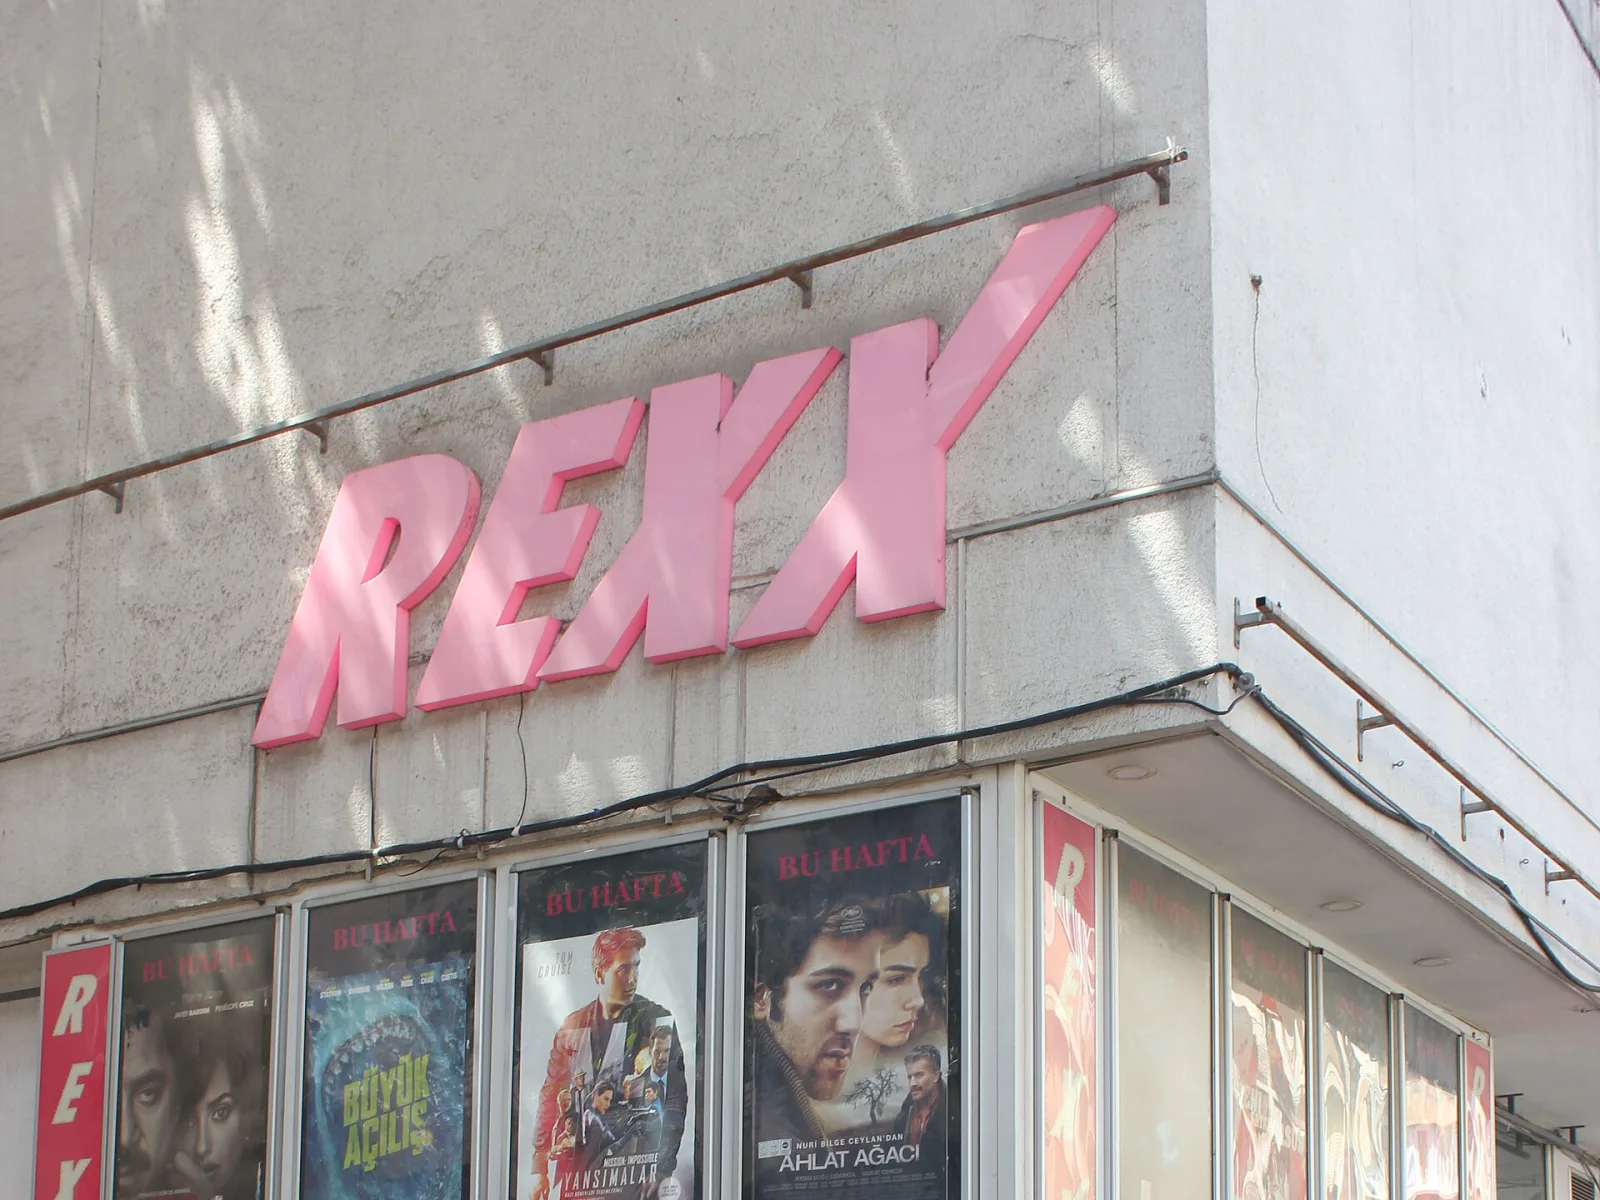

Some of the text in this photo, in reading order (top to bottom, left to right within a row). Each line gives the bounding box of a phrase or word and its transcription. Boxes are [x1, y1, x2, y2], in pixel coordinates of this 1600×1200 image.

[251, 203, 1119, 749] REXX
[778, 833, 935, 880] BU HAFTA
[546, 871, 685, 917] BU HAFTA
[333, 909, 457, 951] BU HAFTA
[141, 944, 254, 984] BU HAFTA
[538, 963, 573, 979] CRUISE
[555, 951, 574, 963] TOM
[343, 1052, 431, 1127] BÜYÜK
[343, 1098, 429, 1173] AÇILIŞ
[848, 1132, 904, 1146] CEYLAN'DAN
[564, 1163, 659, 1191] YANSIMALAR
[778, 1143, 920, 1173] AHLAT AĞACI
